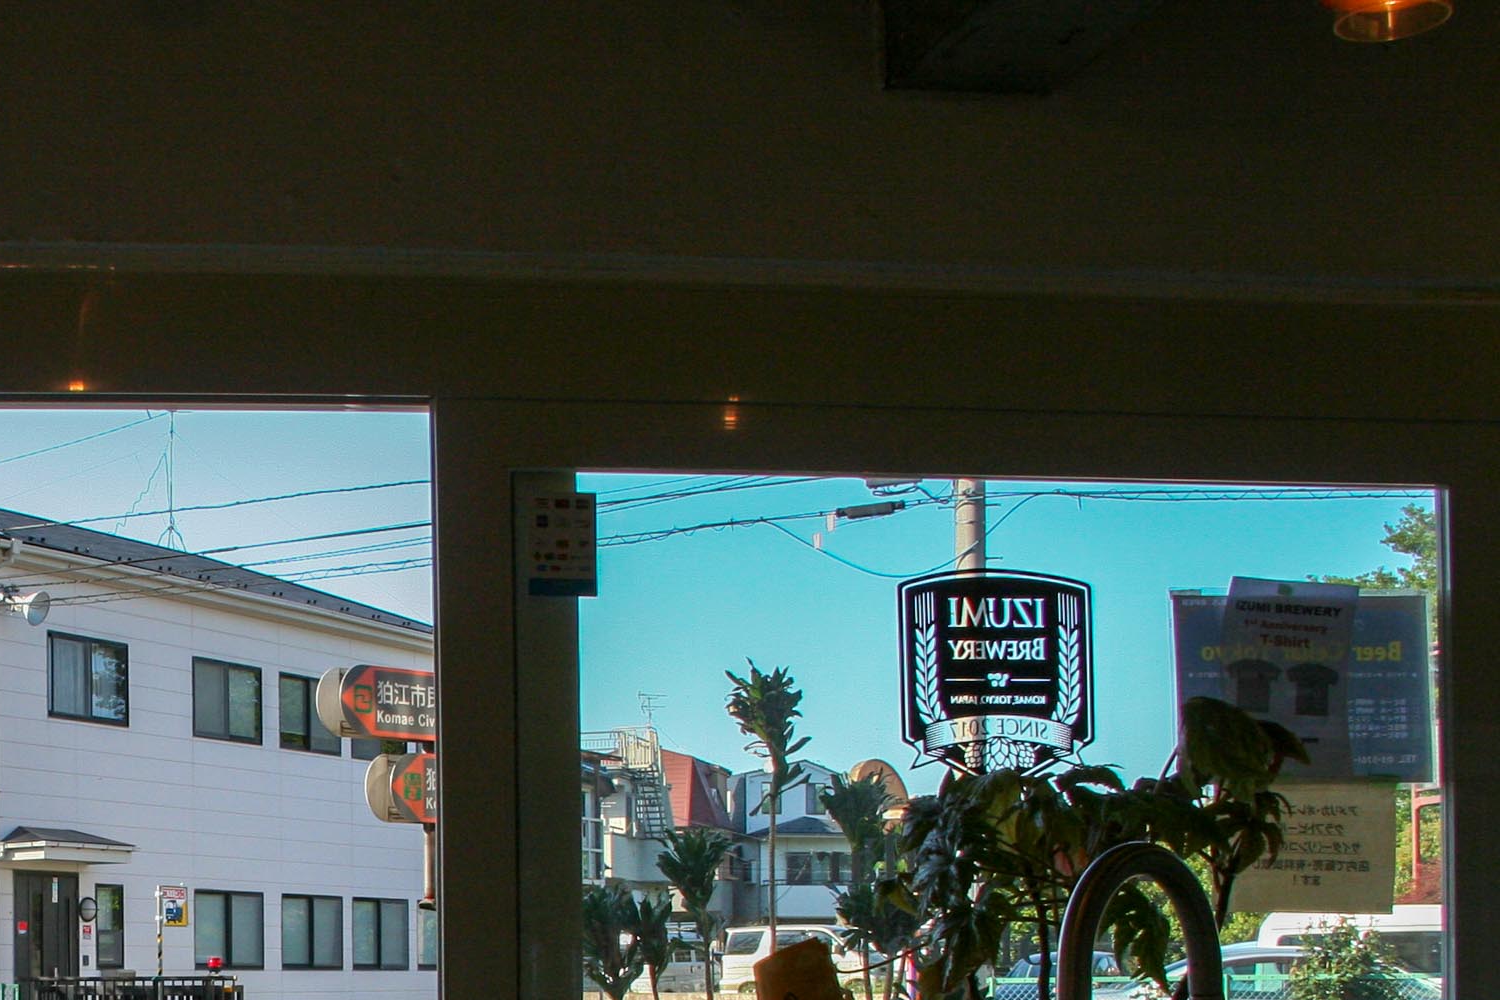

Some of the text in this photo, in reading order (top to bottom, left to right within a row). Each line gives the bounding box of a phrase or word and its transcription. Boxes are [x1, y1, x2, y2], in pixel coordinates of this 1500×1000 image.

[1275, 602, 1342, 617] BREWERY
[1259, 633, 1311, 649] T-Shirt
[376, 709, 415, 726] Komae
